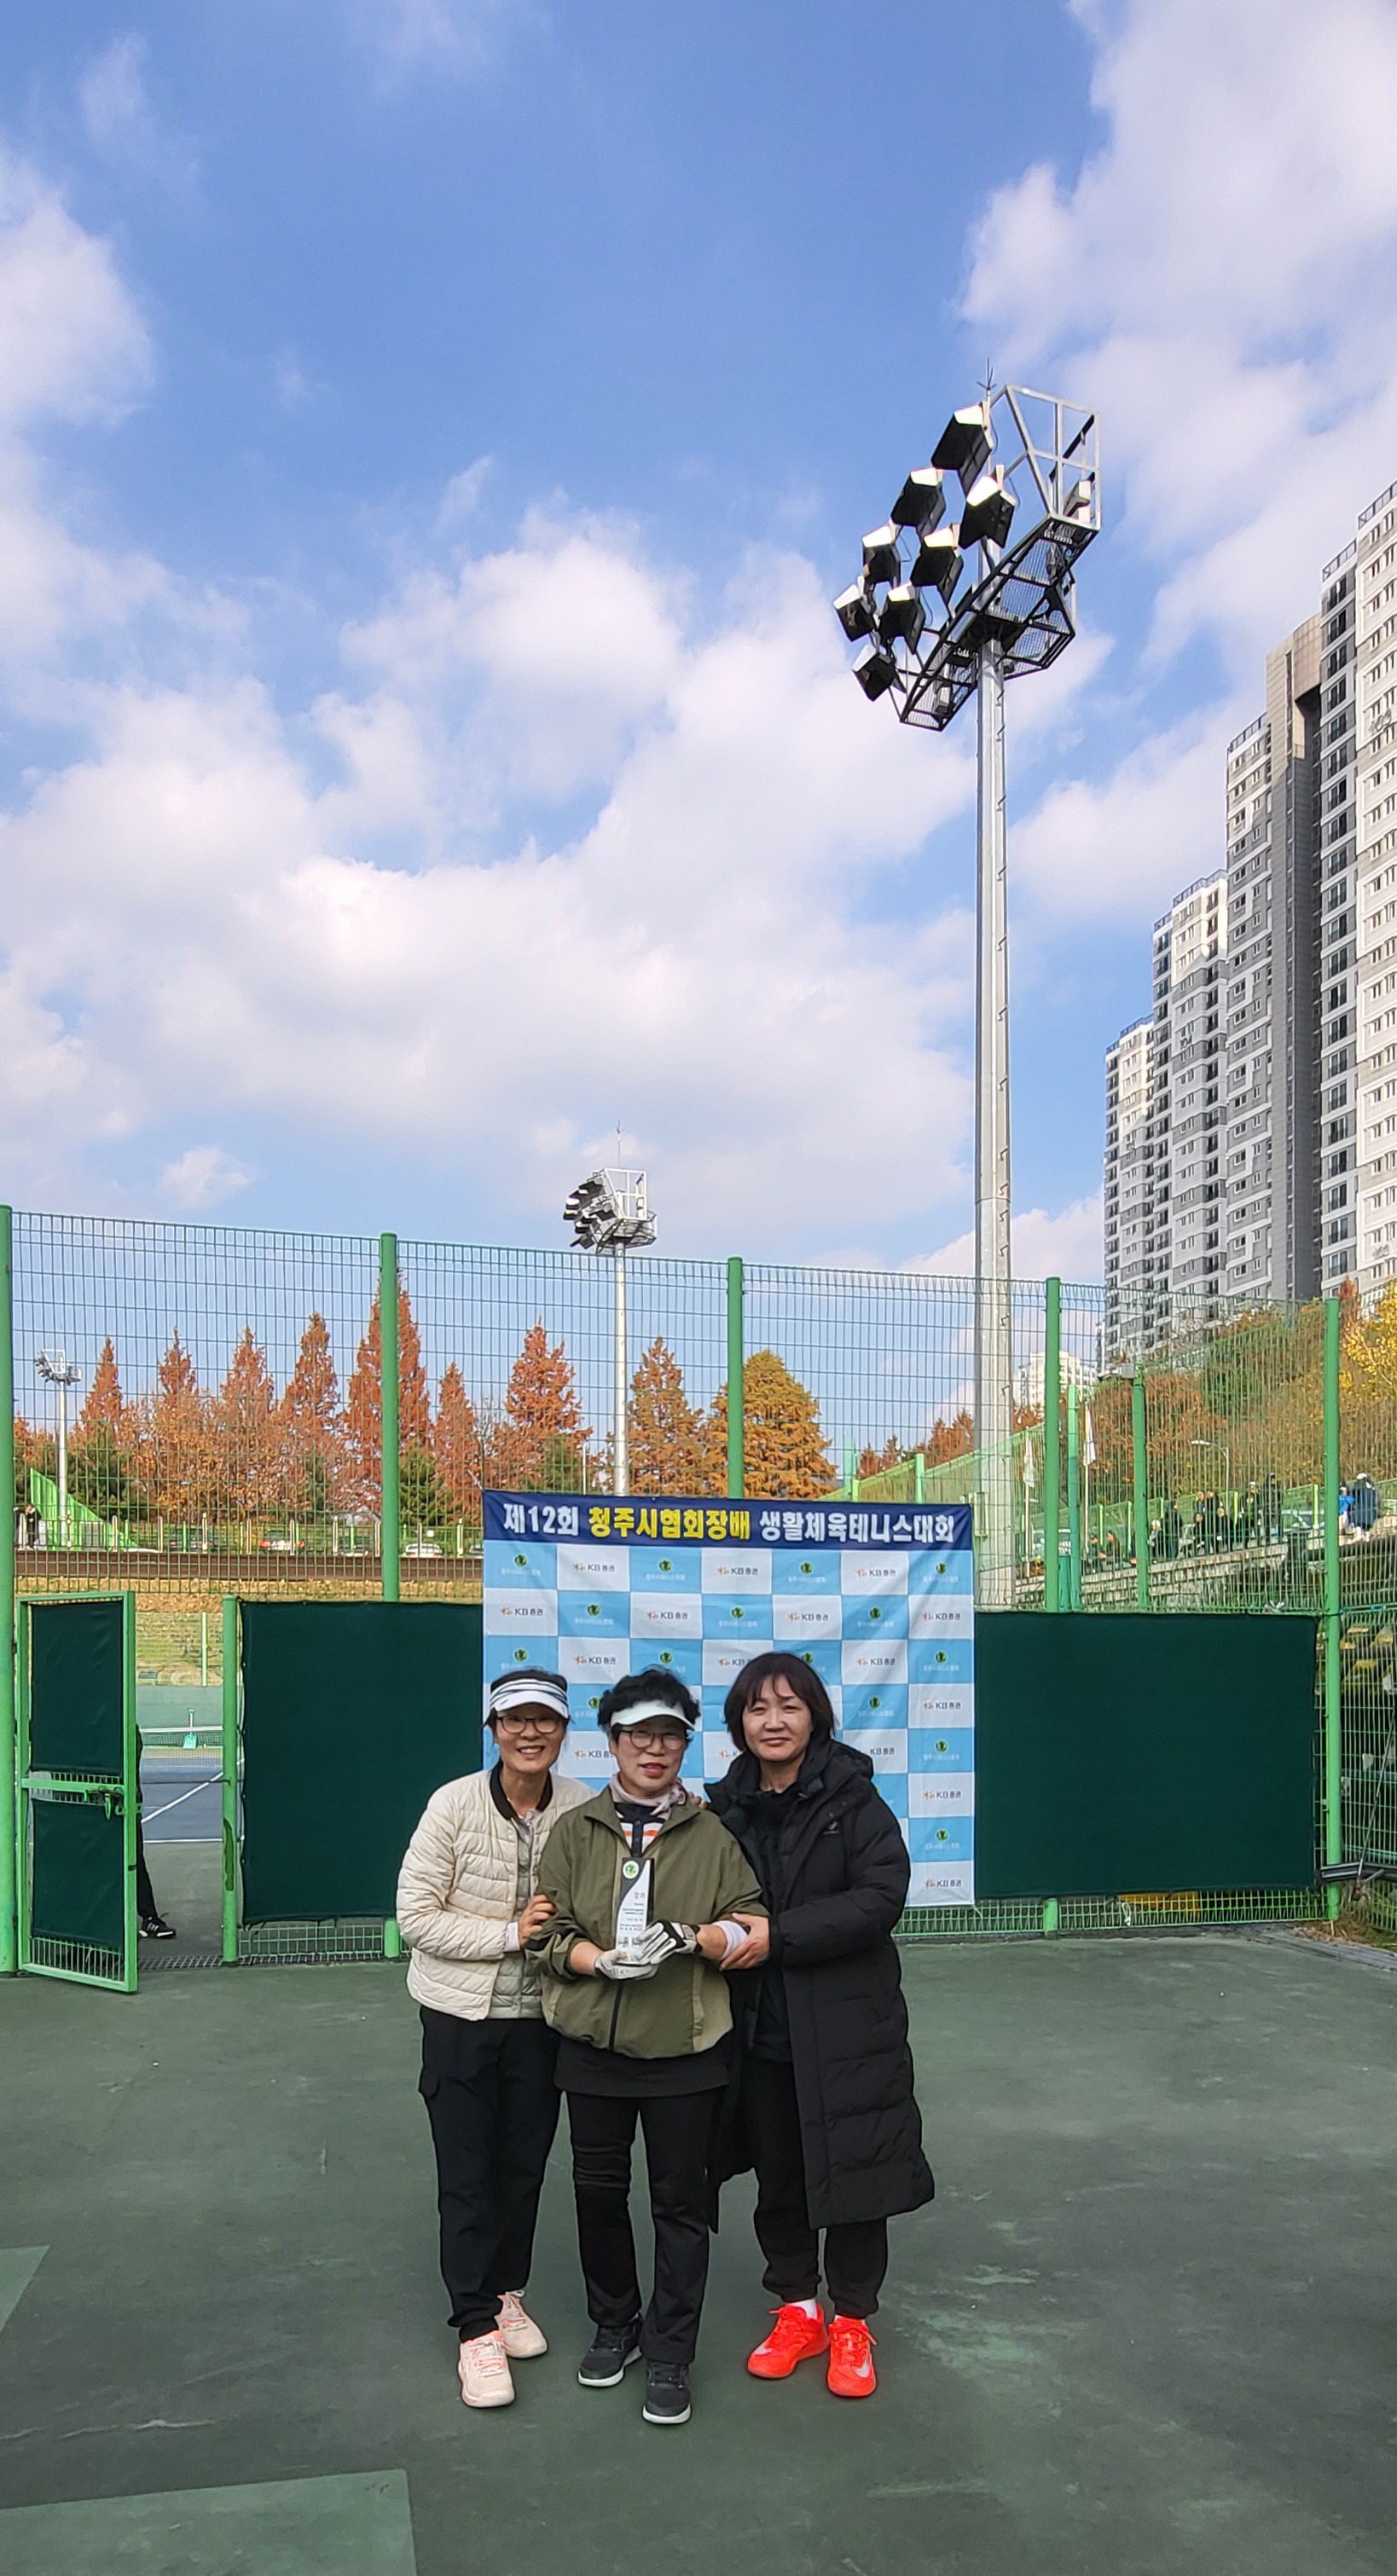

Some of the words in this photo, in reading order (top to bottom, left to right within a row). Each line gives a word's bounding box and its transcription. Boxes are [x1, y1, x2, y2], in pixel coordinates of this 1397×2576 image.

[503, 1503, 578, 1536] 제12회
[588, 1507, 751, 1540] 청주시협회장배
[759, 1510, 954, 1543] 생활체육테니스대회
